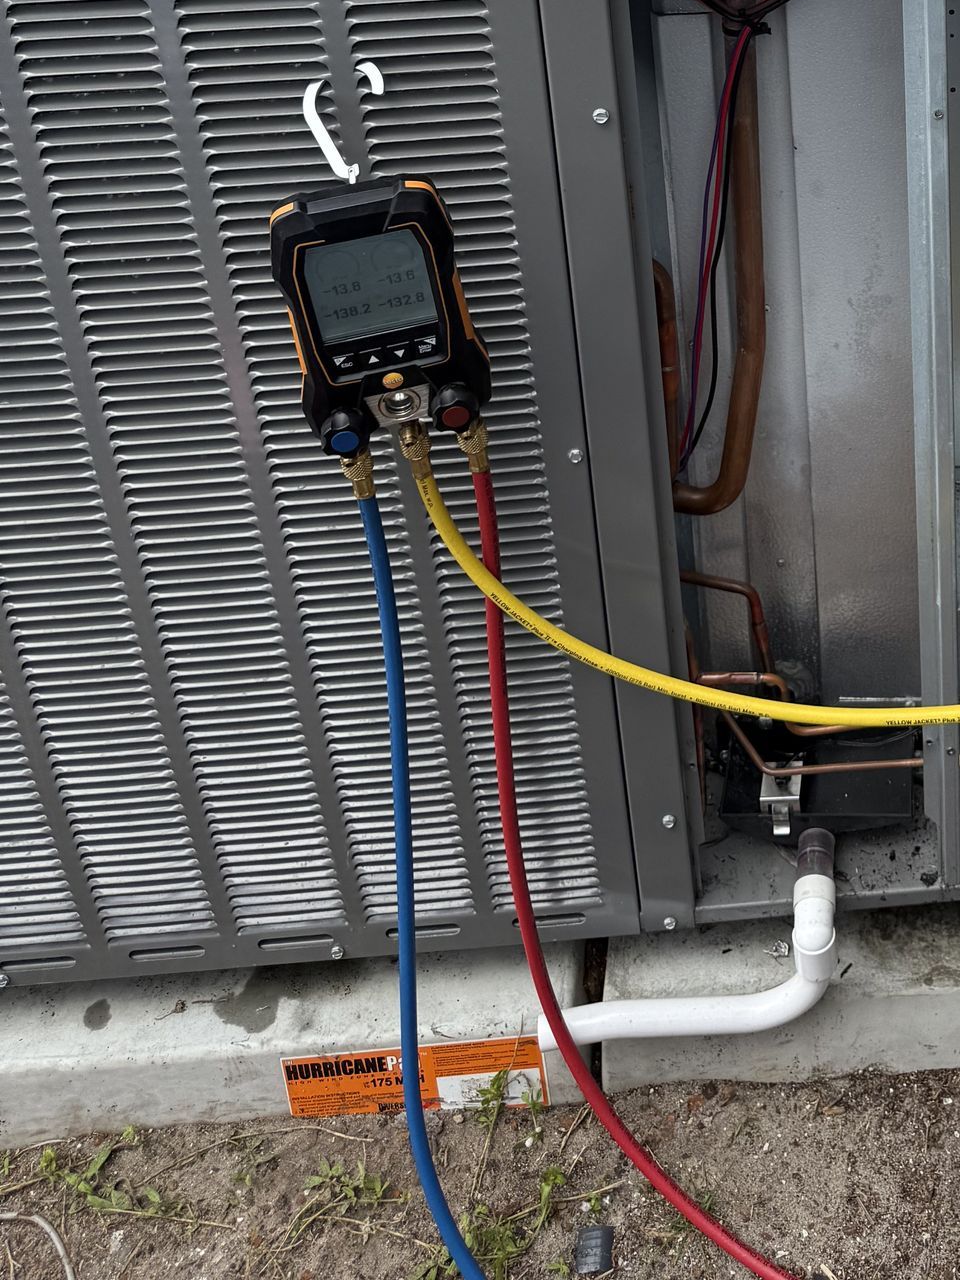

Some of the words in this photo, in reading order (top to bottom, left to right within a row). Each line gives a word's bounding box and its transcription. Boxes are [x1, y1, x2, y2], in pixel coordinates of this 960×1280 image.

[322, 281, 361, 297] -13.8
[324, 303, 372, 320] -138.2
[378, 292, 425, 309] -132.8
[490, 592, 511, 611] YELLOW
[557, 642, 582, 660] Charging
[583, 656, 599, 667] Hose
[285, 1054, 421, 1081] HURRICANEP
[371, 1077, 393, 1088] 175
